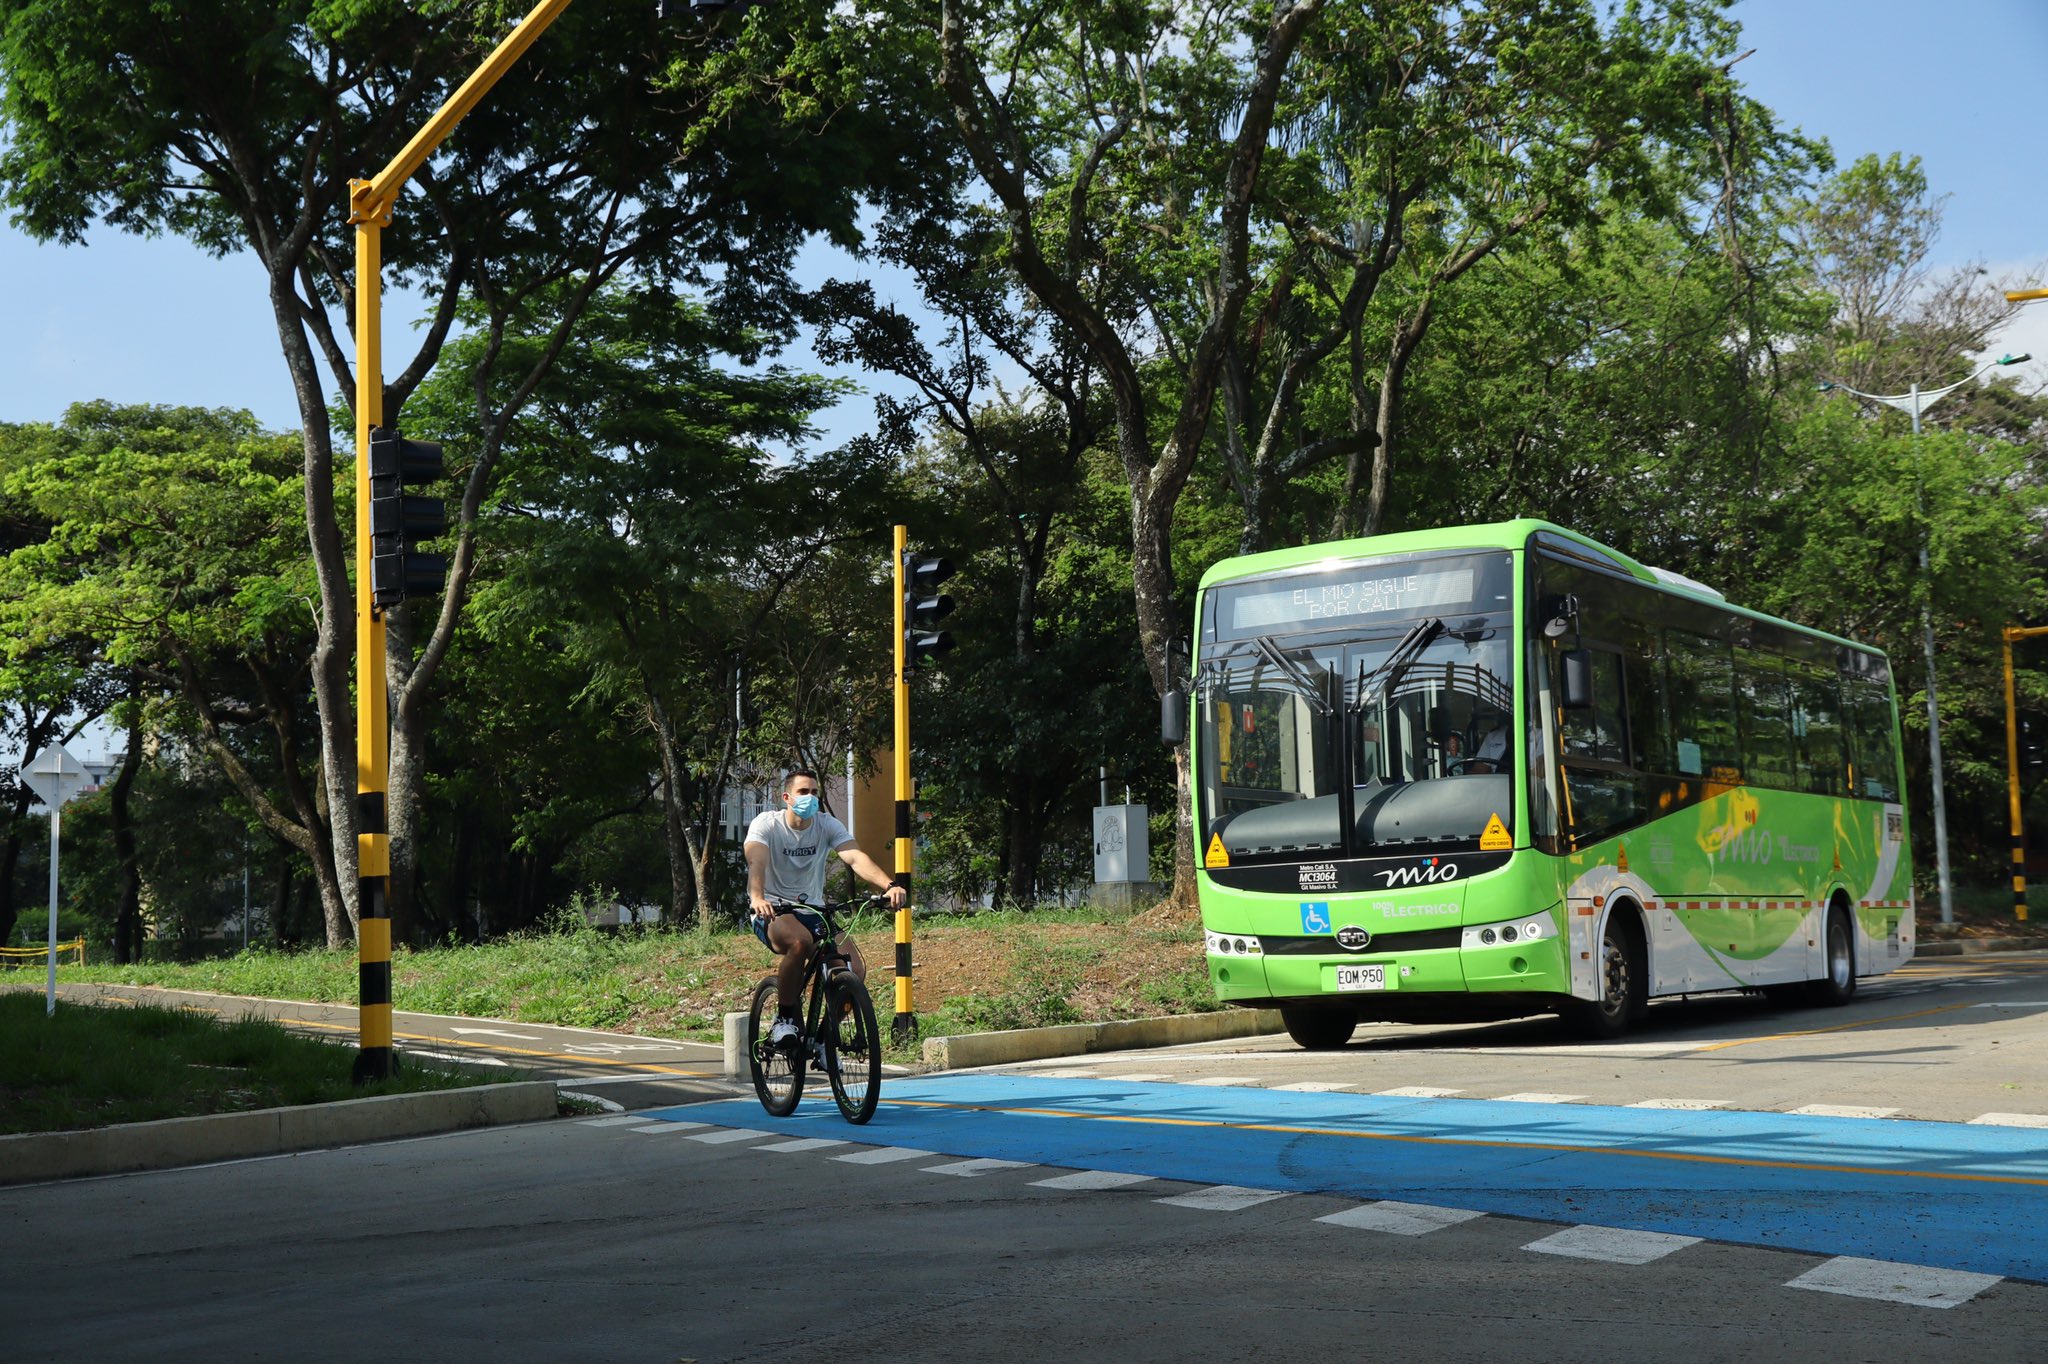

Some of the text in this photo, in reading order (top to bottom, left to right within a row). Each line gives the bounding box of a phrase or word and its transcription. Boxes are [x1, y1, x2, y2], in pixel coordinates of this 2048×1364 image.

[1293, 575, 1418, 605] EL MIO SIGUE
[1310, 594, 1400, 619] POR CALI
[1299, 871, 1336, 882] MC13064
[1338, 932, 1367, 943] BYD
[1361, 968, 1383, 983] 950
